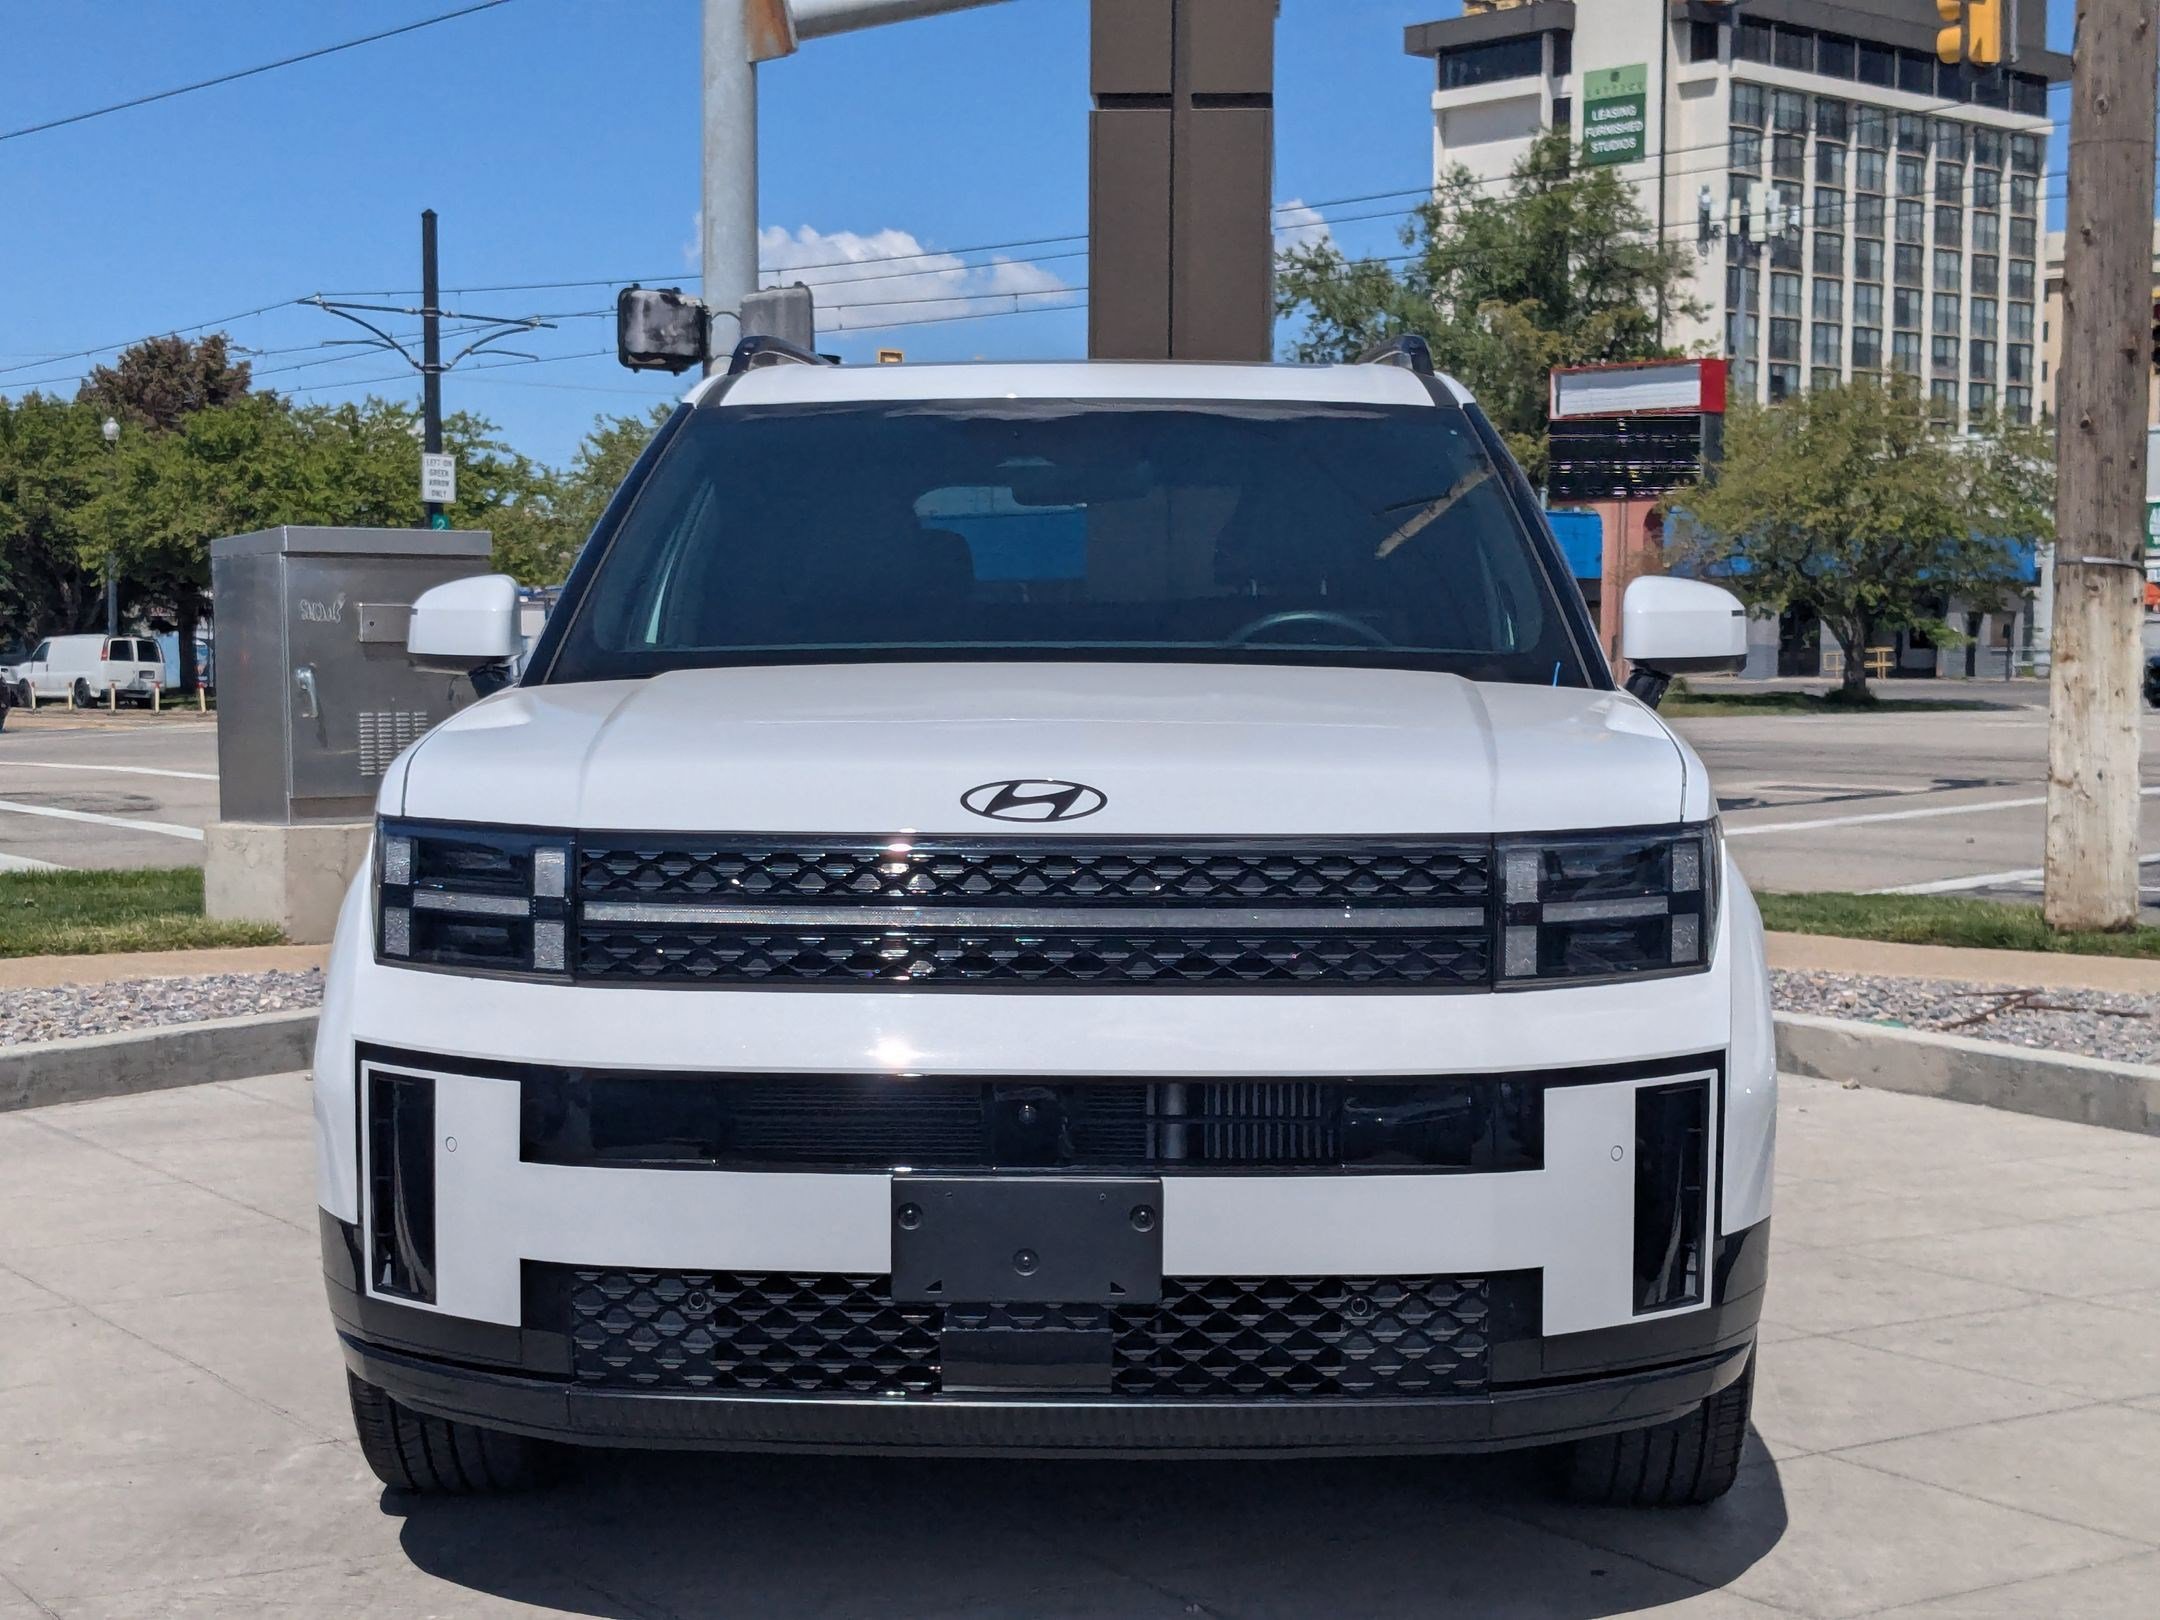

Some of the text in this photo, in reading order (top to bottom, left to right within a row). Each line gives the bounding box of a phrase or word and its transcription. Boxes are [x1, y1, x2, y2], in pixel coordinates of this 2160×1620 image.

[1591, 104, 1637, 121] LEASING
[1585, 120, 1643, 138] FURNISHED
[1590, 137, 1637, 153] STUDIOS
